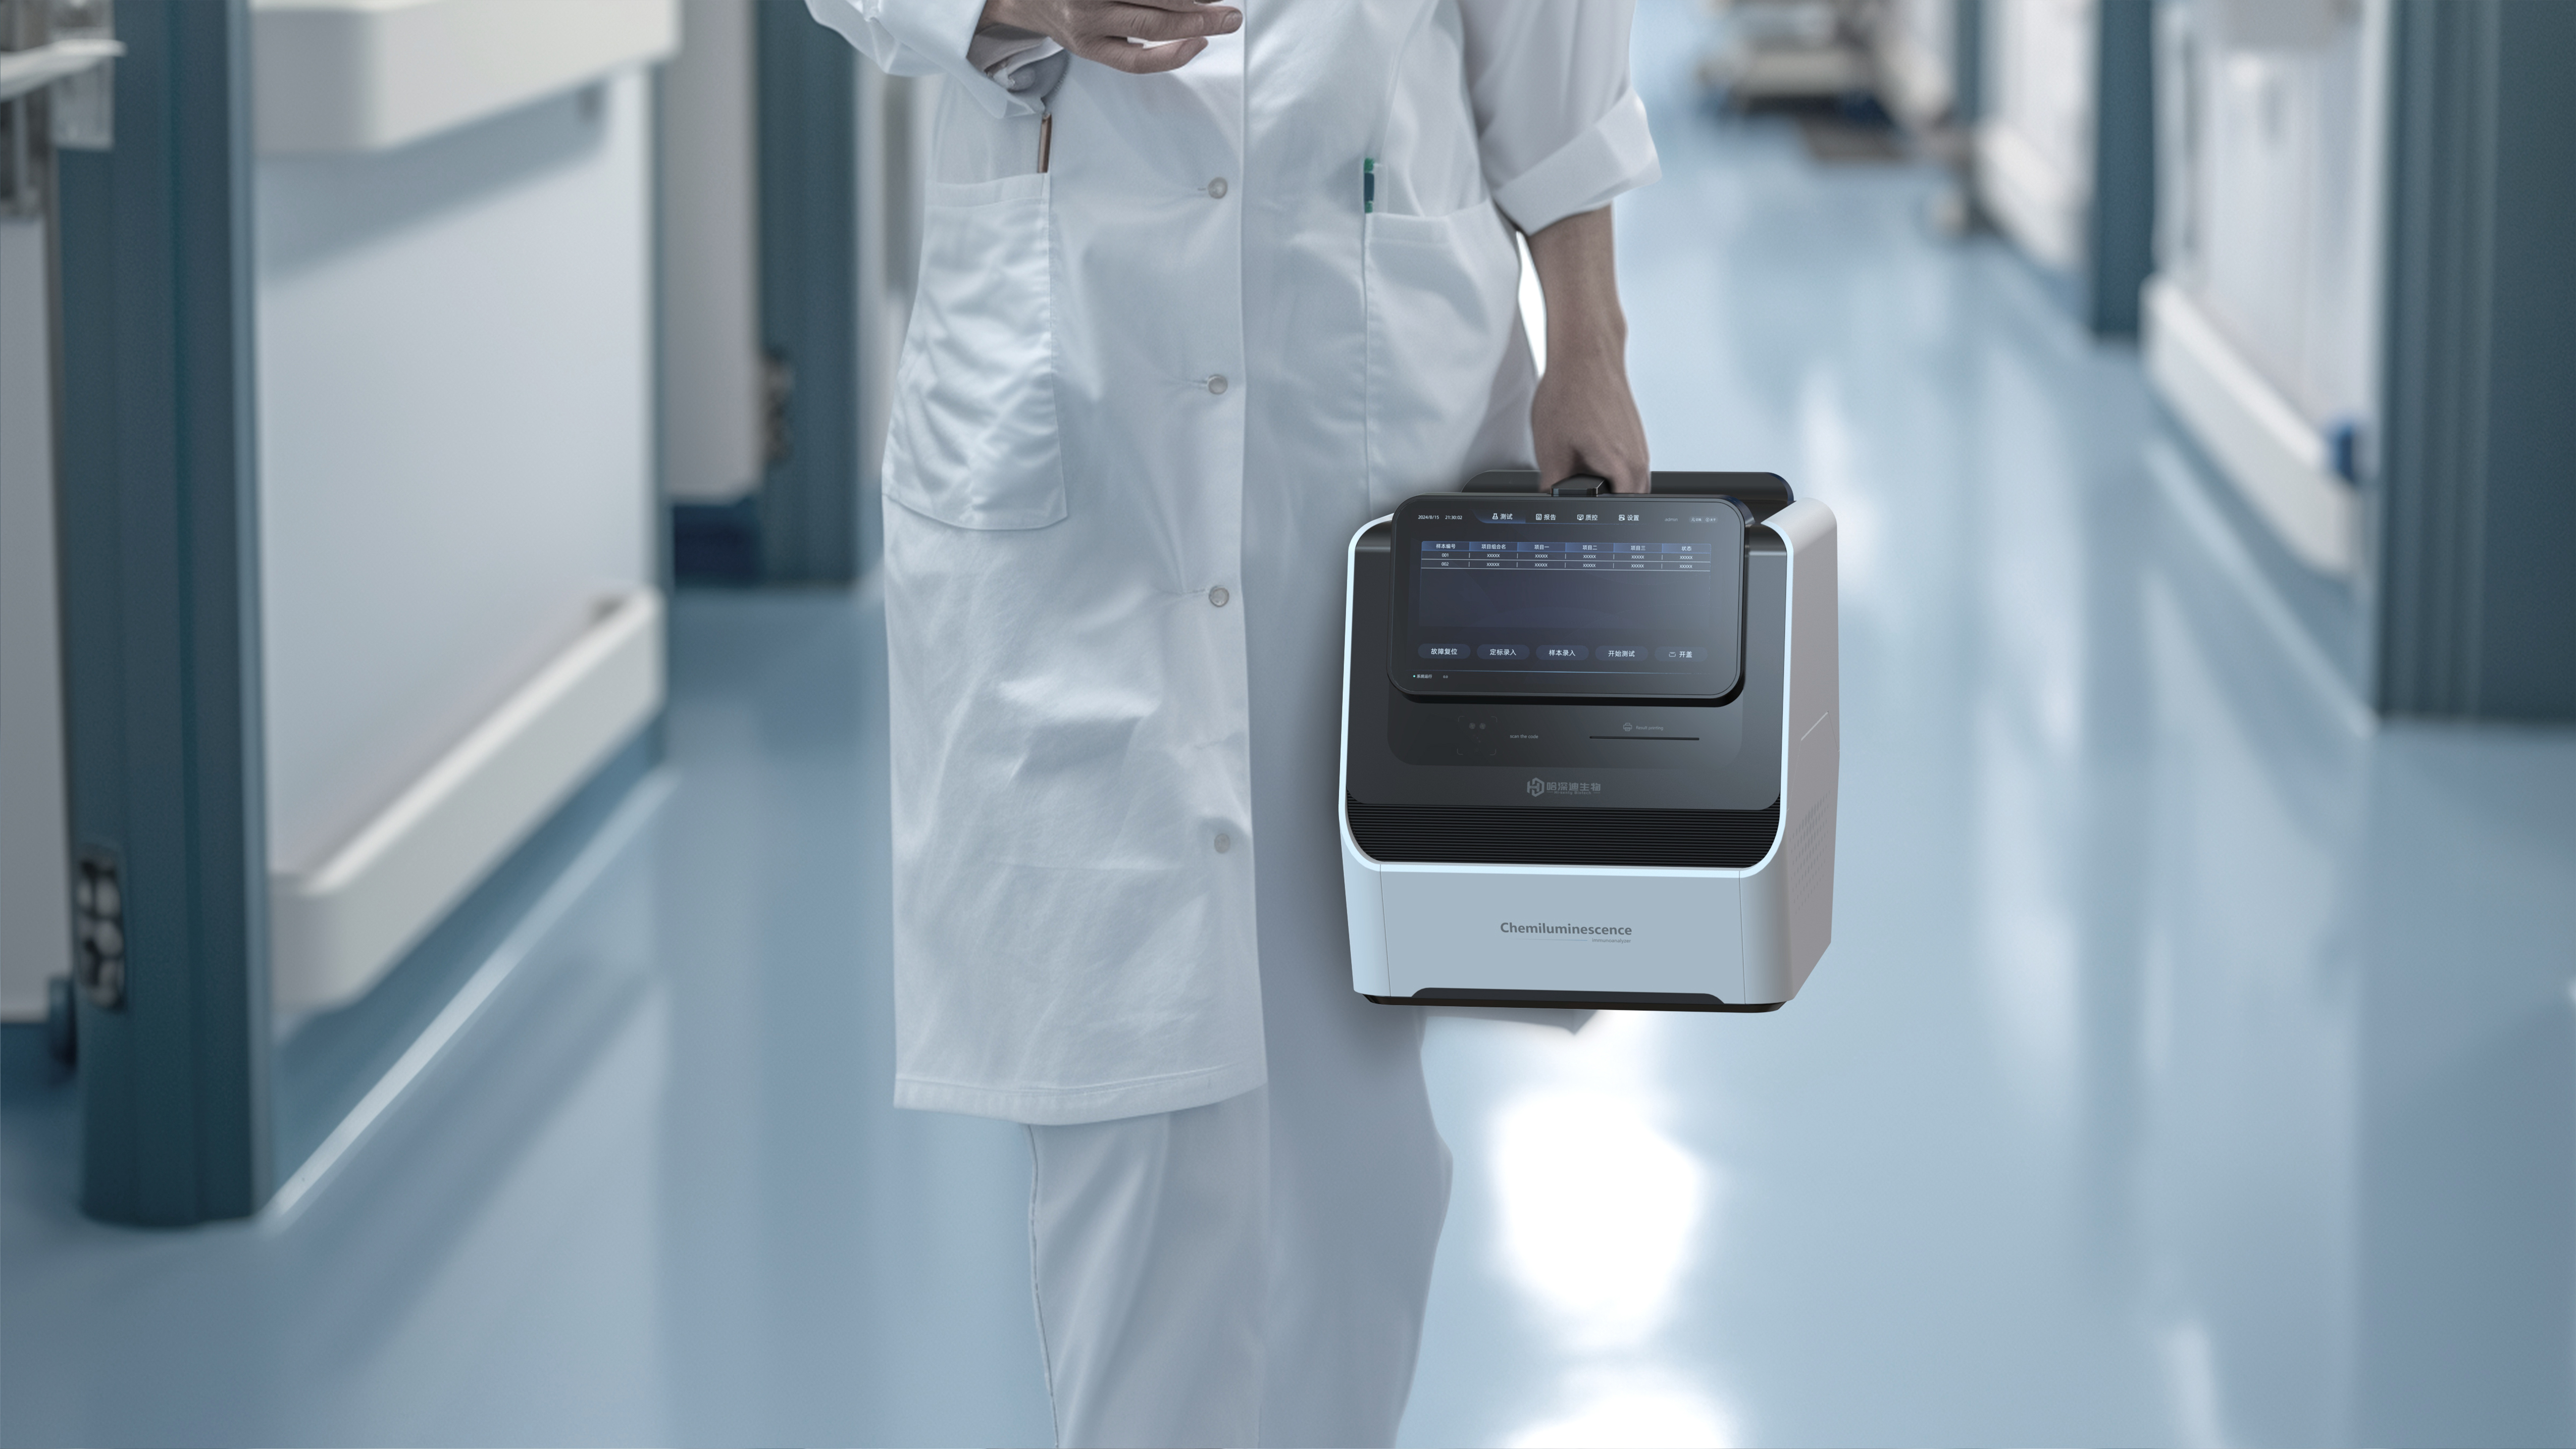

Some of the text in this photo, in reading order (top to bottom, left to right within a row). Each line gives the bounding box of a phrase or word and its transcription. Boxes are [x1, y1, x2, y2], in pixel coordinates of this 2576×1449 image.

[1547, 782, 1601, 791] 哈深迪生物
[1500, 922, 1632, 936] Chemiluminescence
